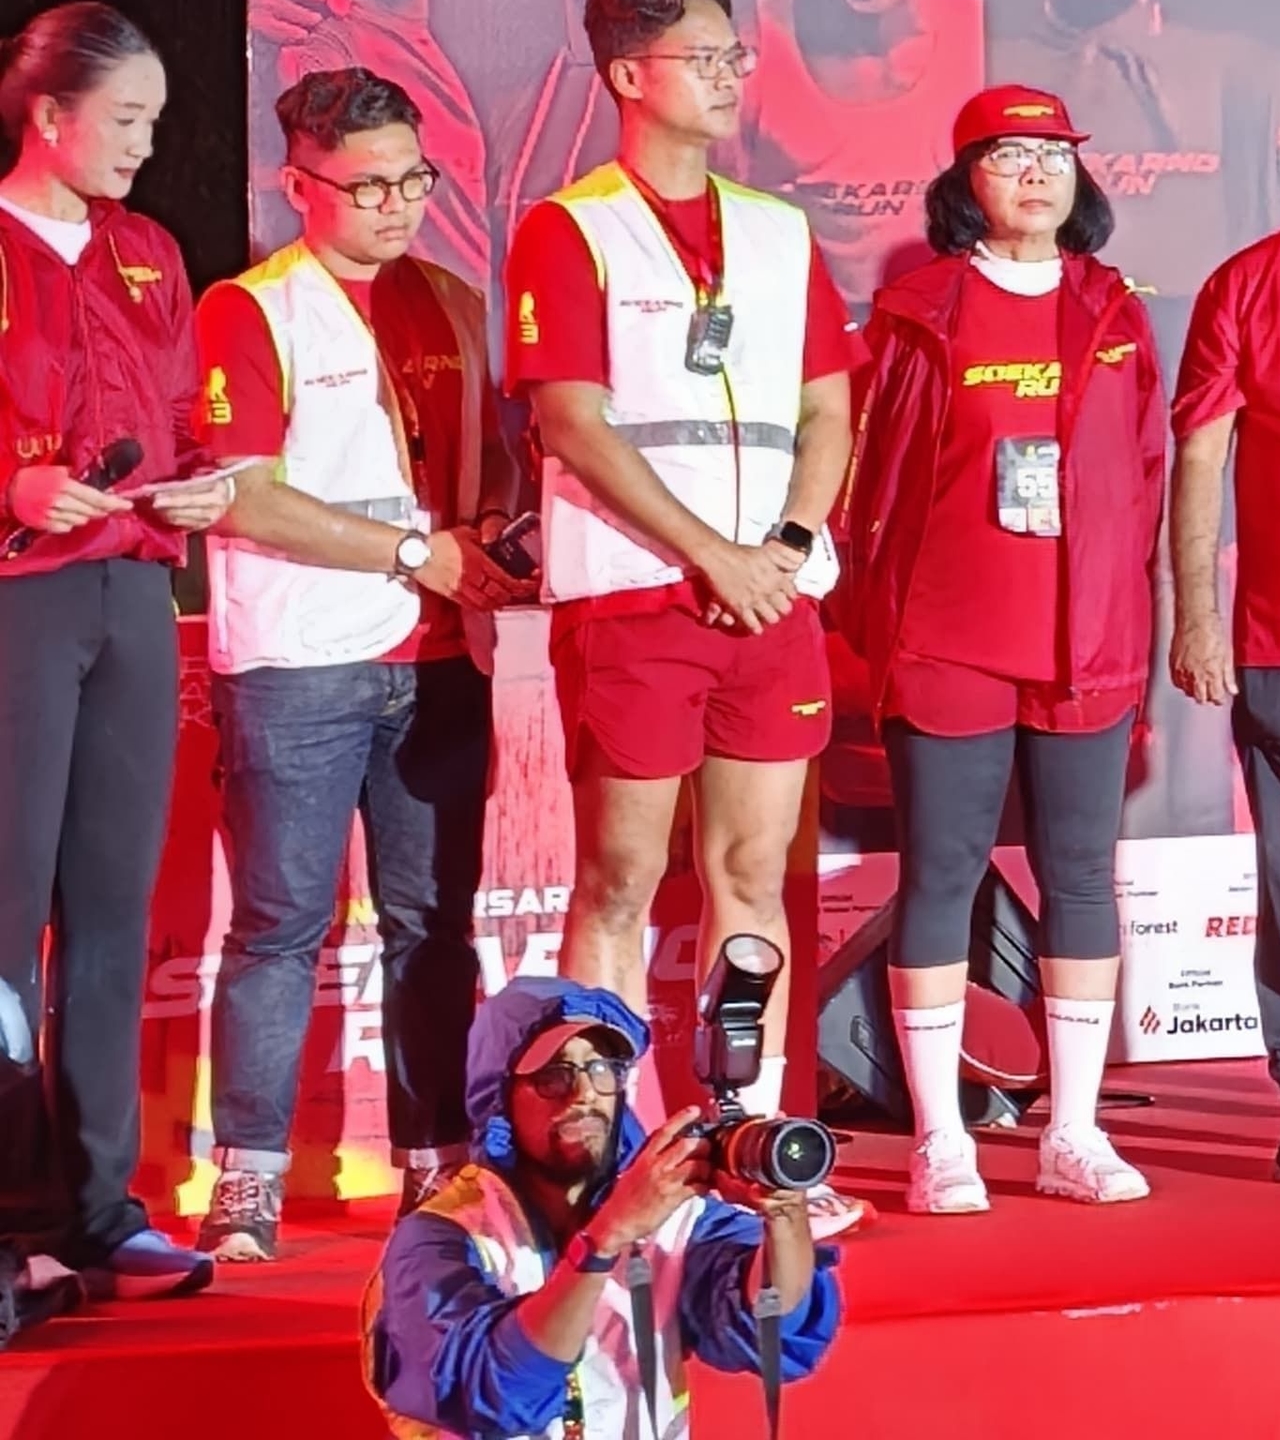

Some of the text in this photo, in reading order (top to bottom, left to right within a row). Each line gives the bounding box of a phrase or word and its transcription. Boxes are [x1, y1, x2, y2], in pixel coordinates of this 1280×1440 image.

[963, 361, 1062, 386] SOEKA
[1014, 377, 1061, 398] RU
[1166, 1013, 1258, 1035] Jakarta
